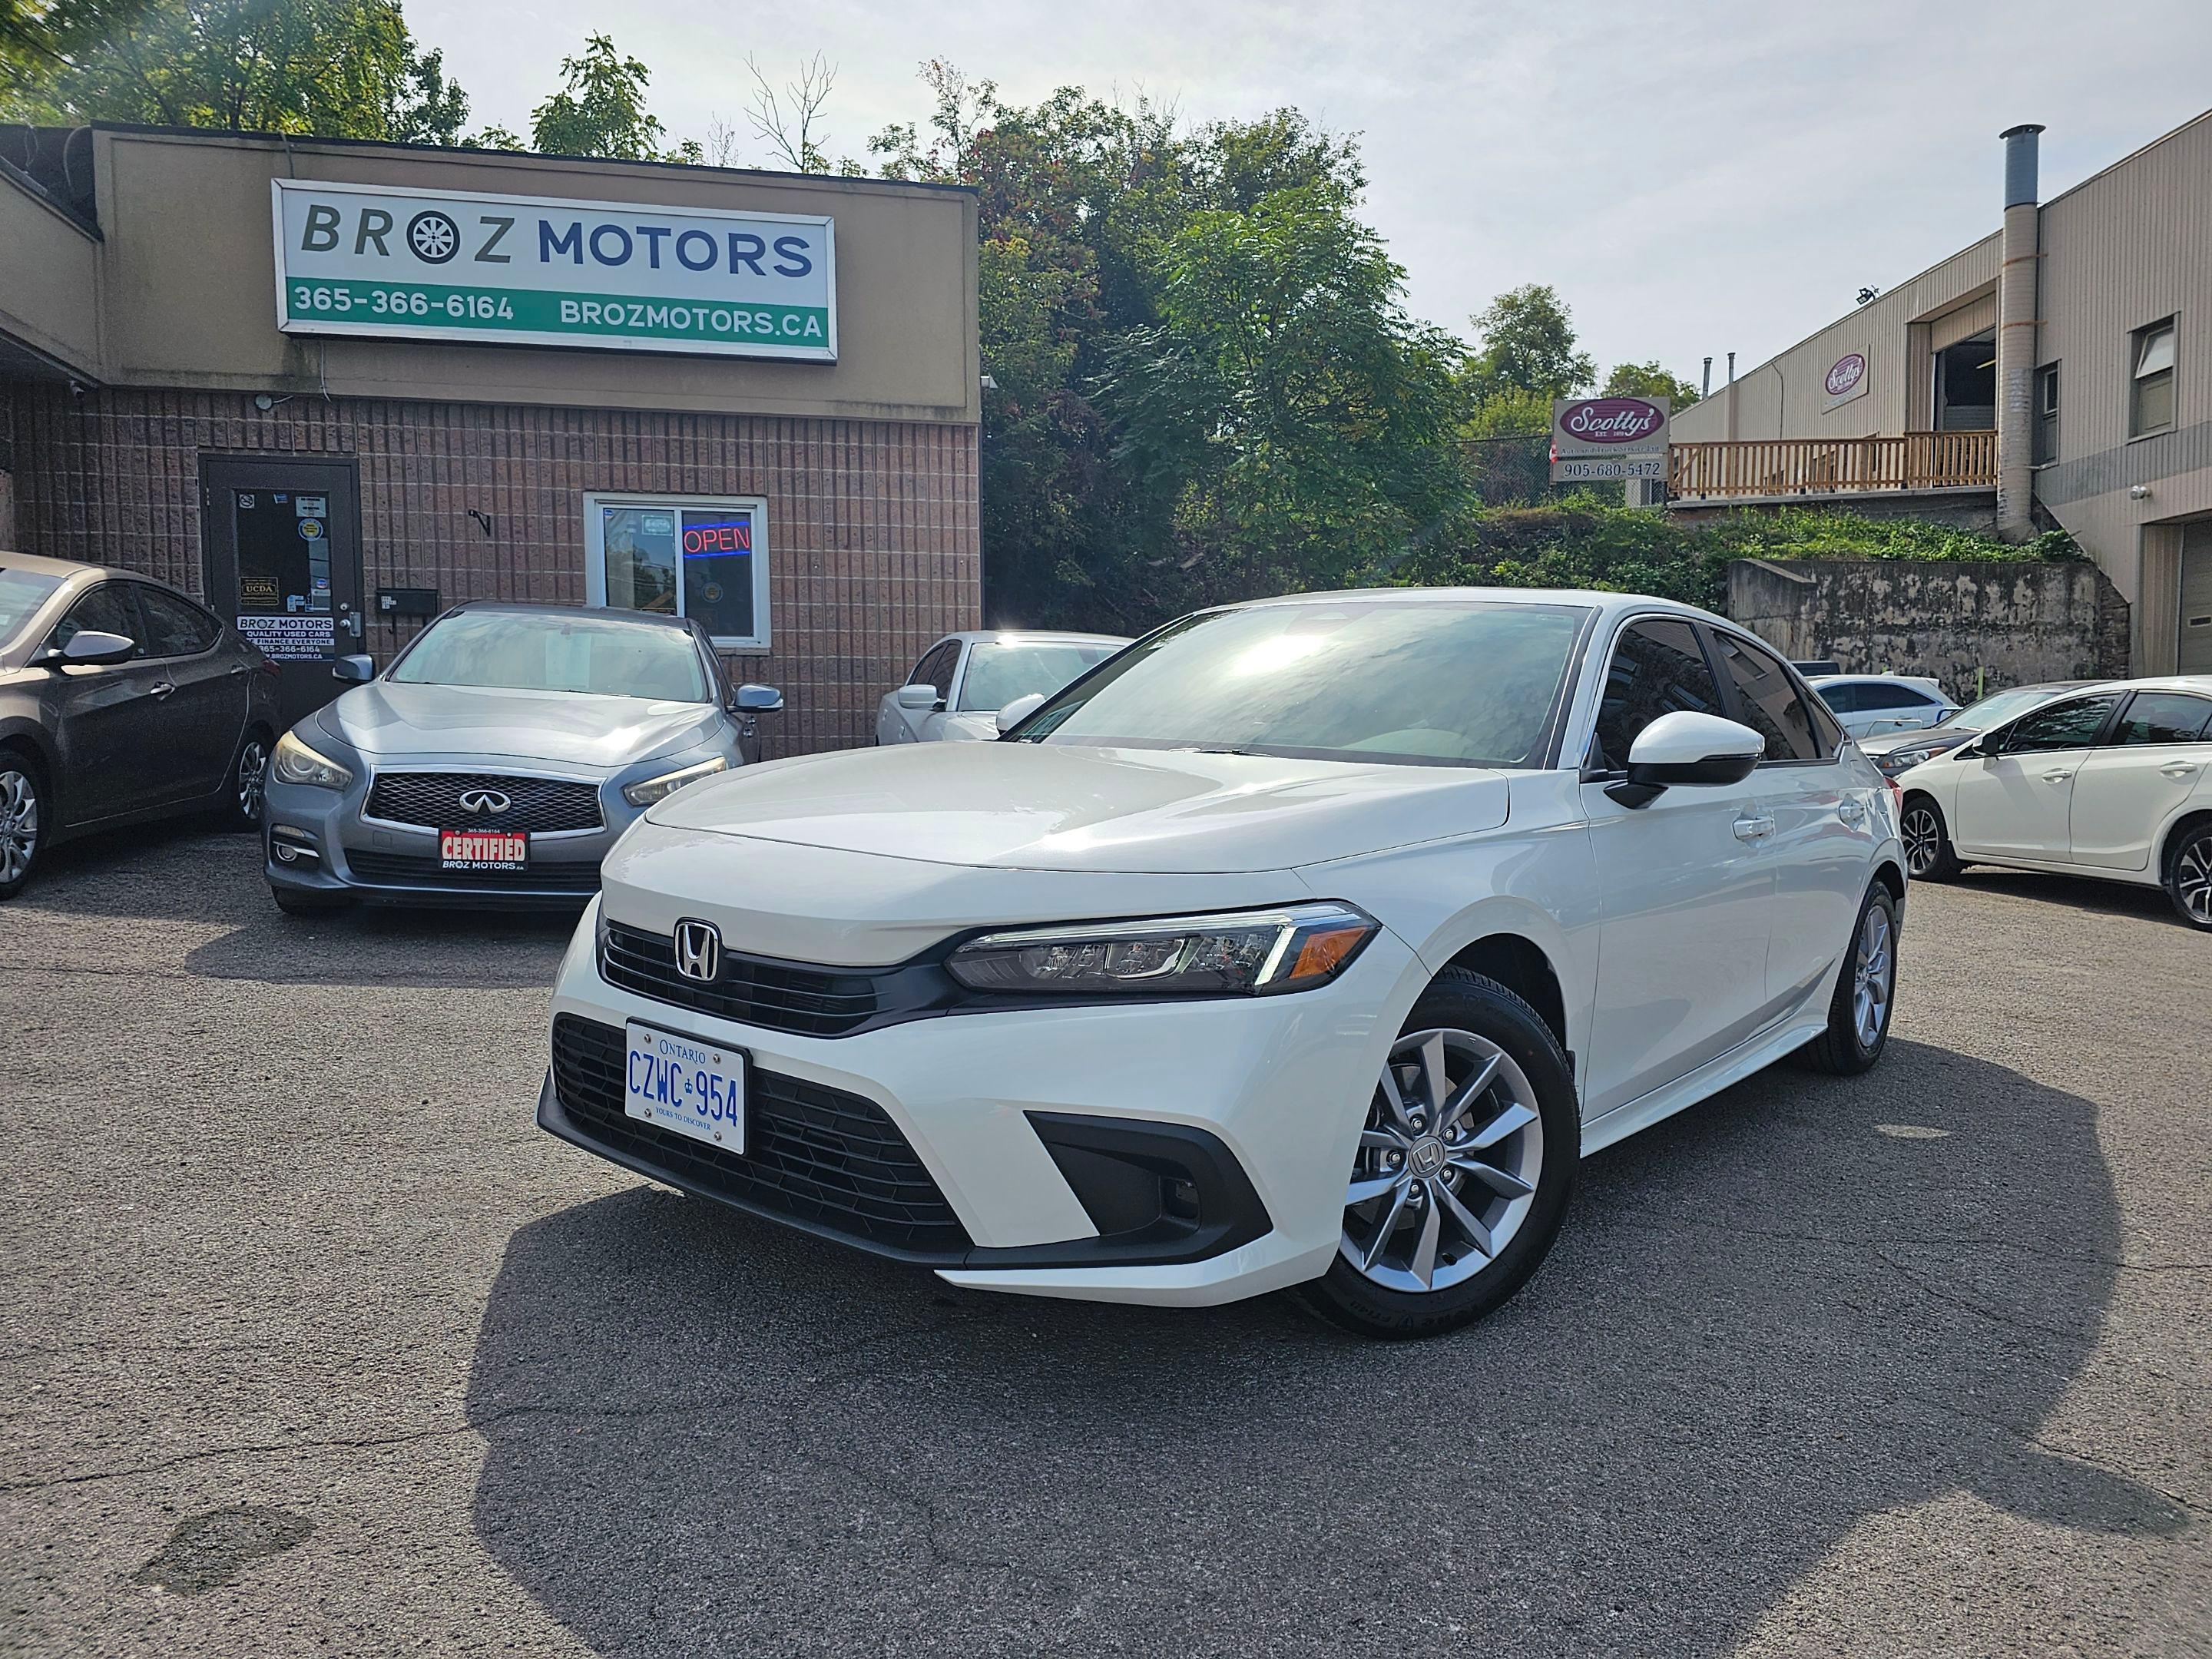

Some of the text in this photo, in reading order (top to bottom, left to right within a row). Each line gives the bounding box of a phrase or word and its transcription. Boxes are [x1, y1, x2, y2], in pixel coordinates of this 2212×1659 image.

[301, 204, 813, 278] BROZ MOTORS
[294, 286, 514, 320] 365-366-6164
[561, 300, 822, 338] BROZMOTORS.CA
[1570, 406, 1655, 436] Scotty's
[1564, 462, 1661, 477] 905-680-5472
[684, 528, 750, 553] OPEN
[240, 619, 332, 629] BROZ MOTORS
[442, 836, 526, 862] CERTIFIED
[660, 1039, 706, 1065] ONTARIO
[629, 1050, 738, 1127] CZWC 954
[655, 1107, 673, 1118] YOURS
[684, 1116, 710, 1130] DISCOVER
